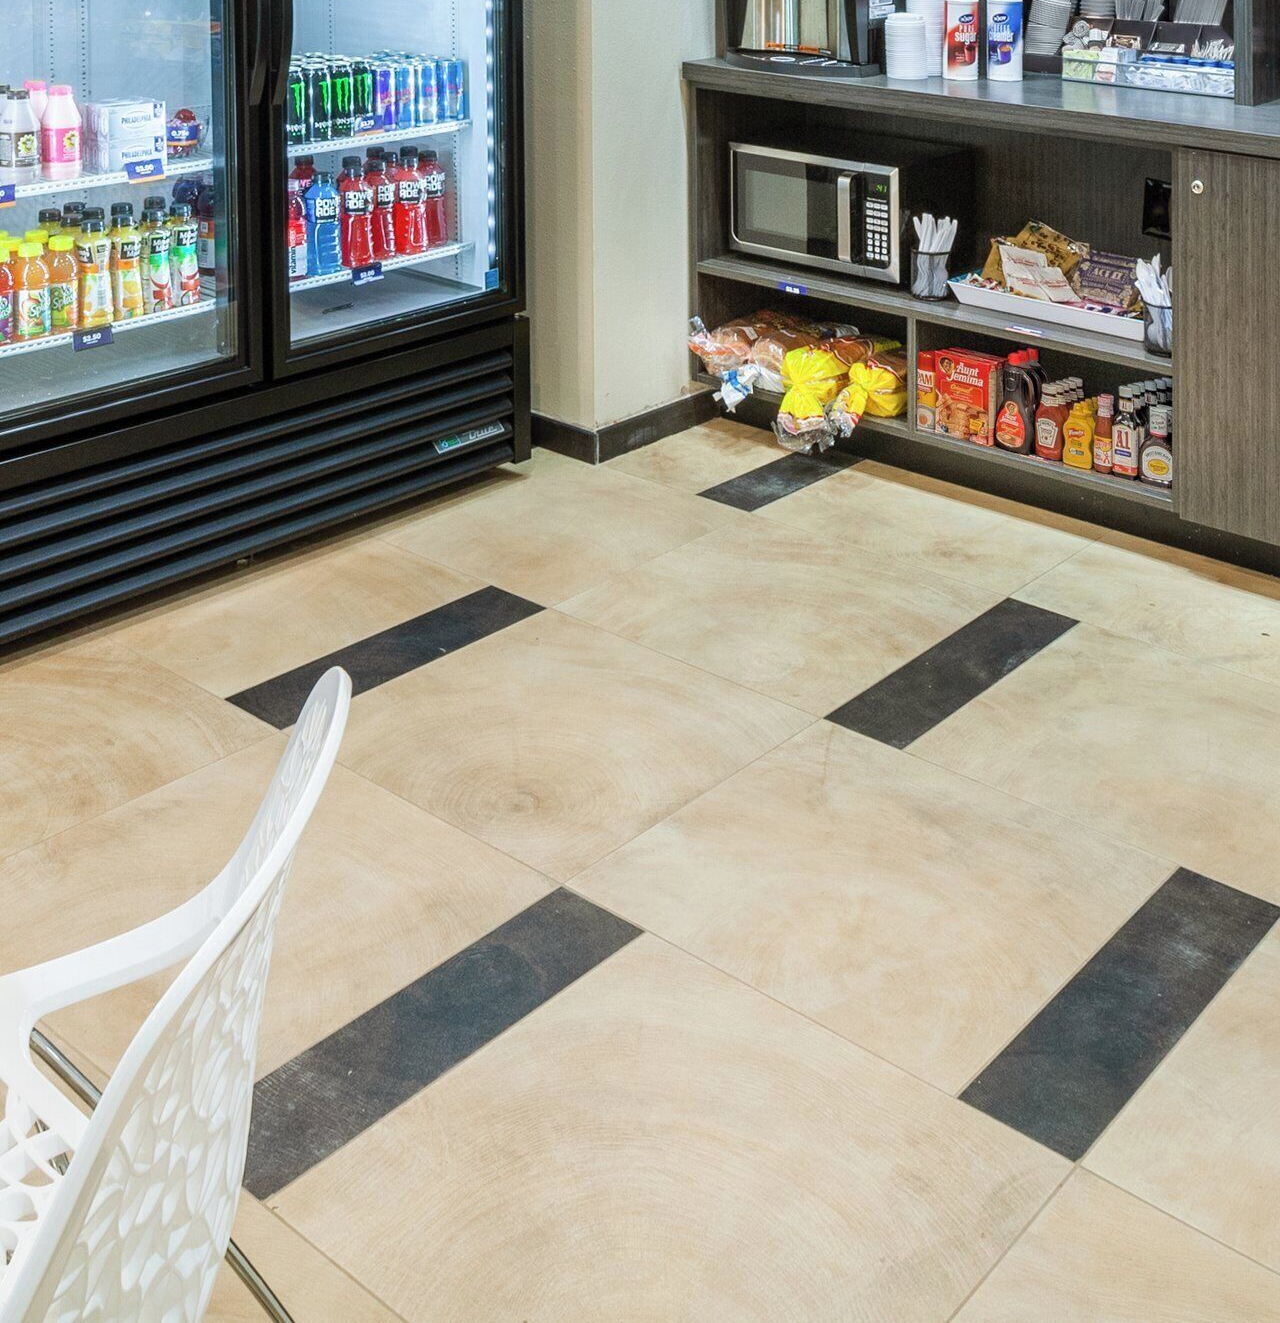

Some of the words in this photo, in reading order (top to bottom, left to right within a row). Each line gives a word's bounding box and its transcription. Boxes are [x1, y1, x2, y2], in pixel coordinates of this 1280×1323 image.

[954, 31, 977, 44] sugar
[956, 362, 979, 376] Aunt
[948, 371, 984, 387] Jemima
[1116, 430, 1131, 450] A1
